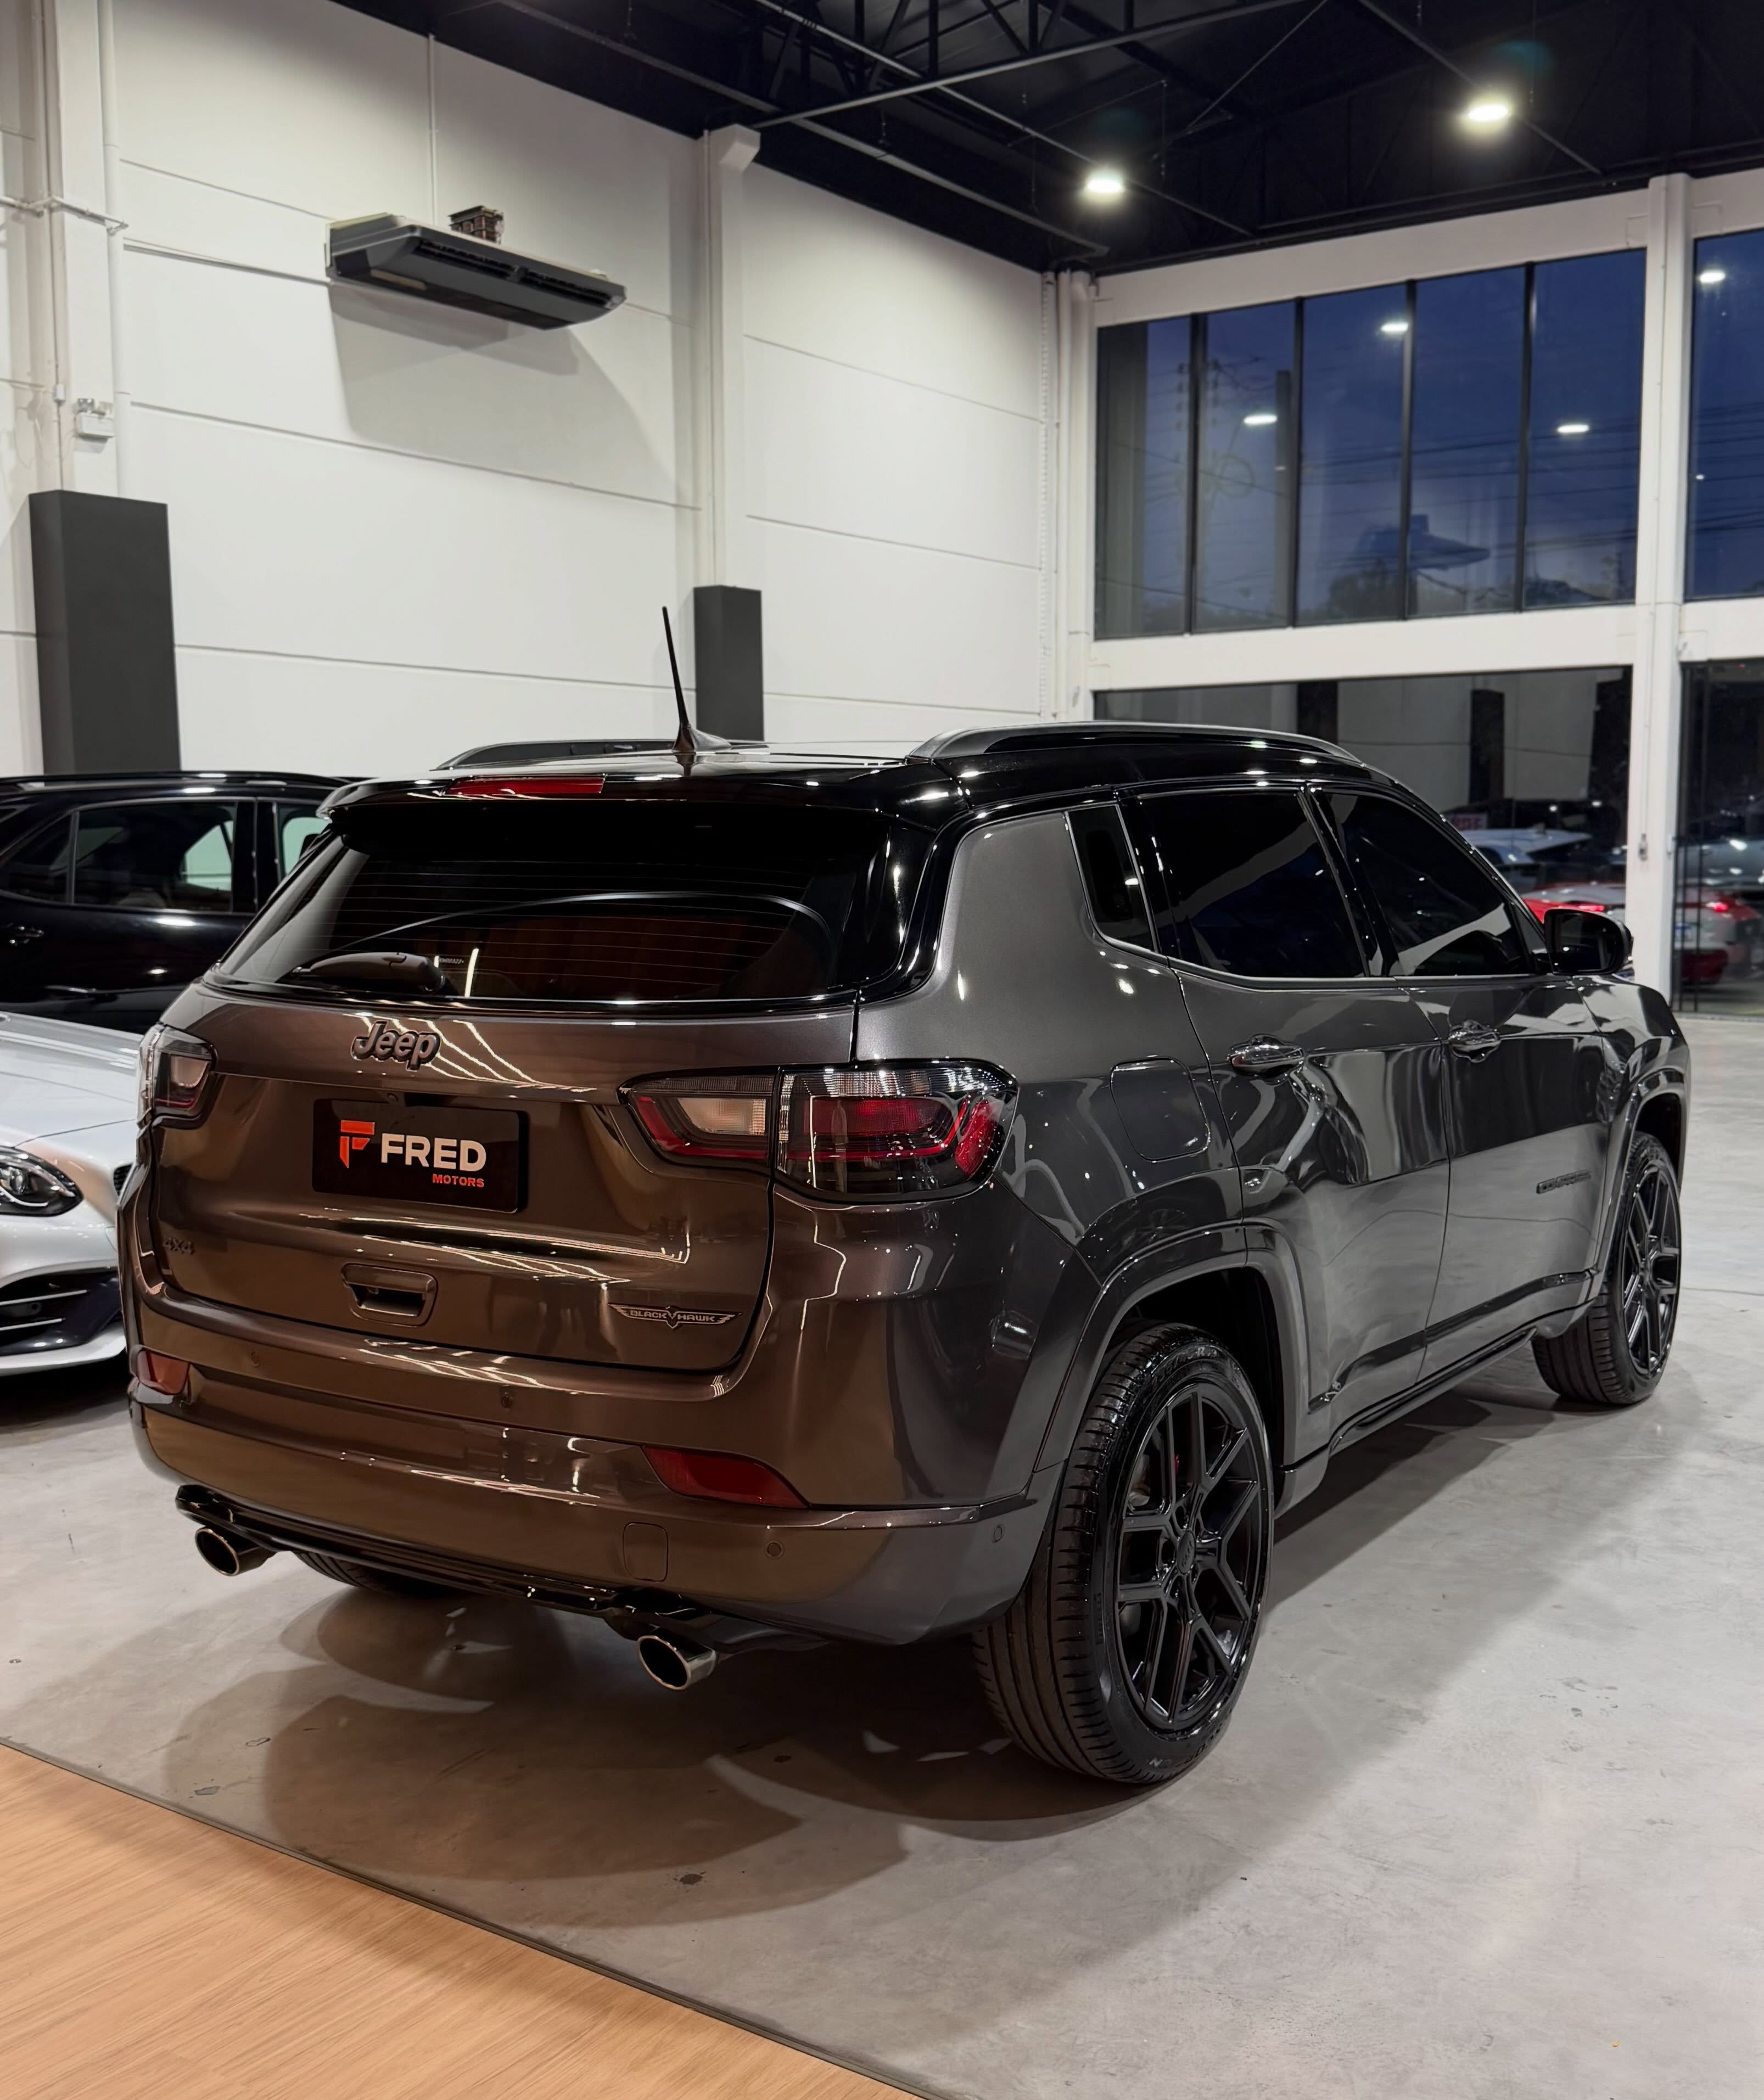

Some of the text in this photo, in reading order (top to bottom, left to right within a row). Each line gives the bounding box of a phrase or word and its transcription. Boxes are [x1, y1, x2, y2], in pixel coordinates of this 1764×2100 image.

[351, 1021, 440, 1070] Jeep
[381, 1133, 486, 1172] FRED
[432, 1173, 485, 1188] MOTORS
[630, 1310, 667, 1319] BLACK
